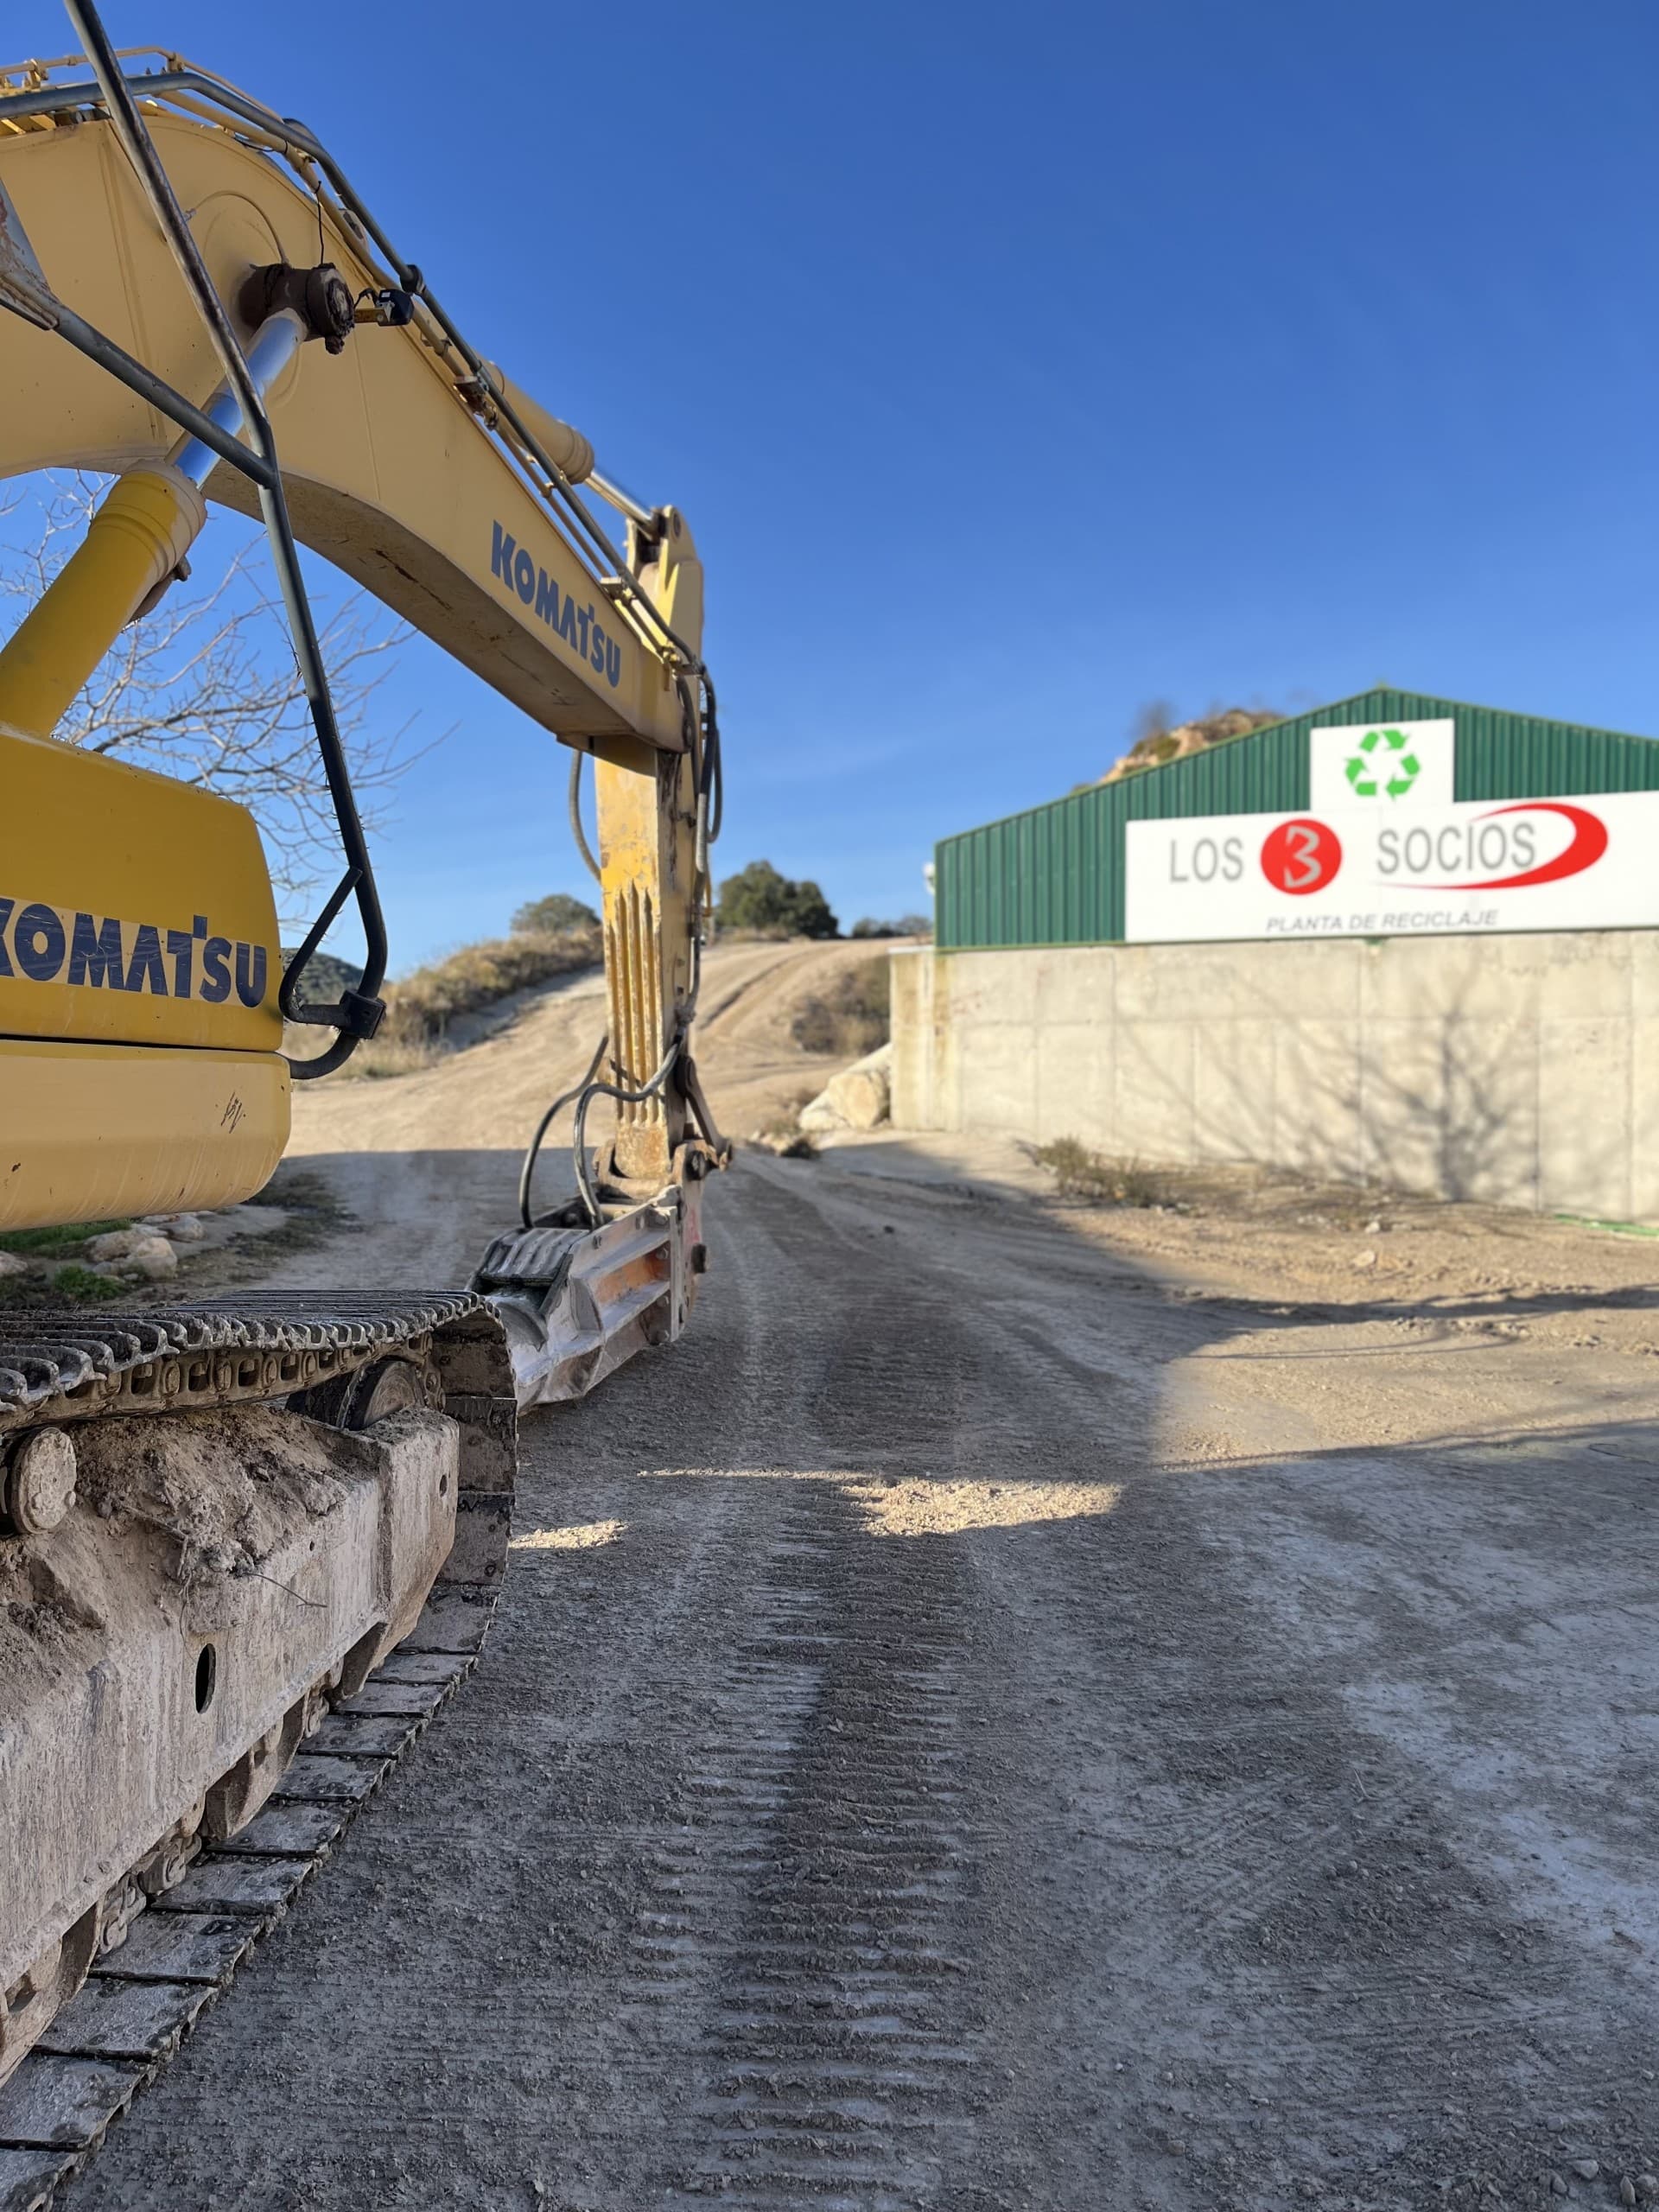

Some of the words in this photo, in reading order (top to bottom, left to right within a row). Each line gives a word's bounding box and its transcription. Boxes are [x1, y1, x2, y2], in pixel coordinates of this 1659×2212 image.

[491, 519, 621, 688] KOMATSU
[1169, 836, 1244, 883] LOS
[1283, 825, 1322, 888] 3
[1377, 821, 1536, 874] SOCIOS
[0, 897, 267, 1008] OMATSU
[1266, 916, 1344, 932] PLANTA
[1349, 914, 1376, 930] DE
[1382, 909, 1498, 929] RECICLAJE
